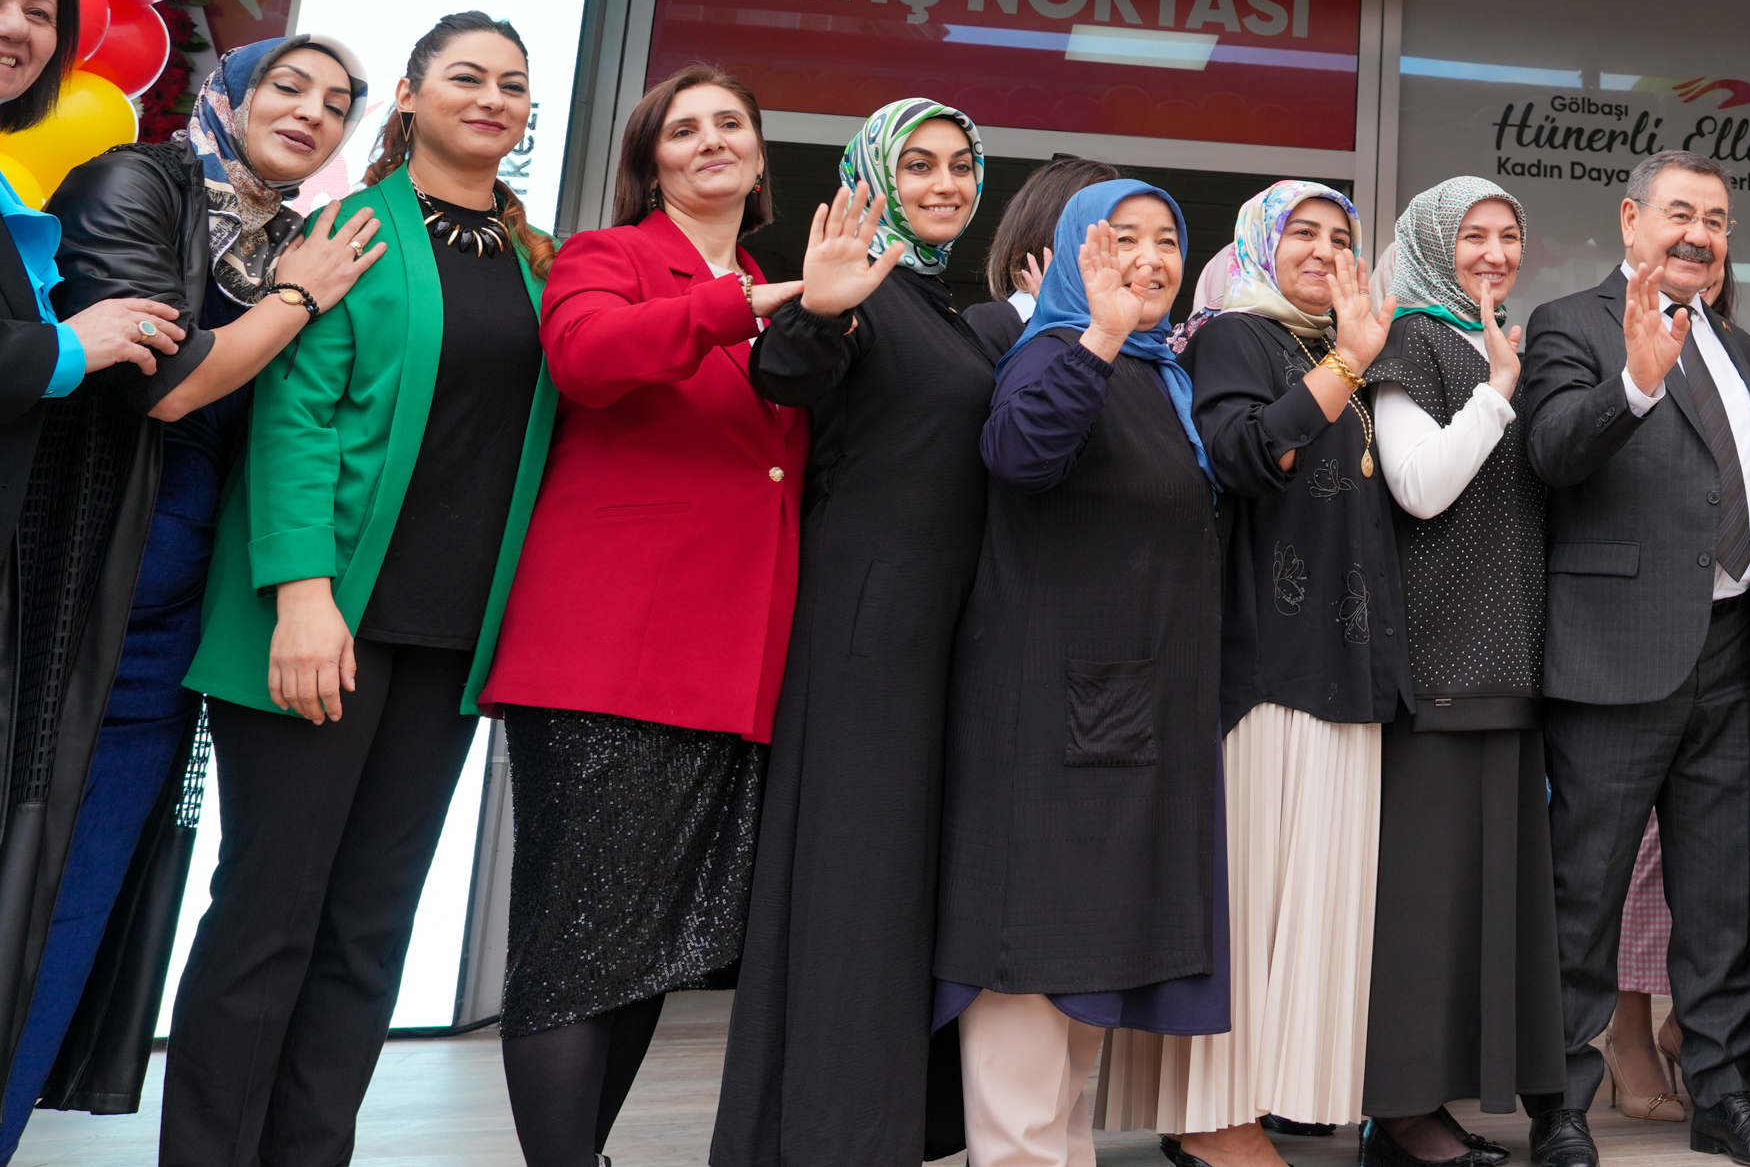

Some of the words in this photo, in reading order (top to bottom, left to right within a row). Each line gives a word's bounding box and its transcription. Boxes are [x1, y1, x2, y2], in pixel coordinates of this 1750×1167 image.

[1551, 95, 1629, 121] Gölbaşı
[1492, 102, 1664, 155] Hünerli
[1497, 156, 1562, 179] Kadın
